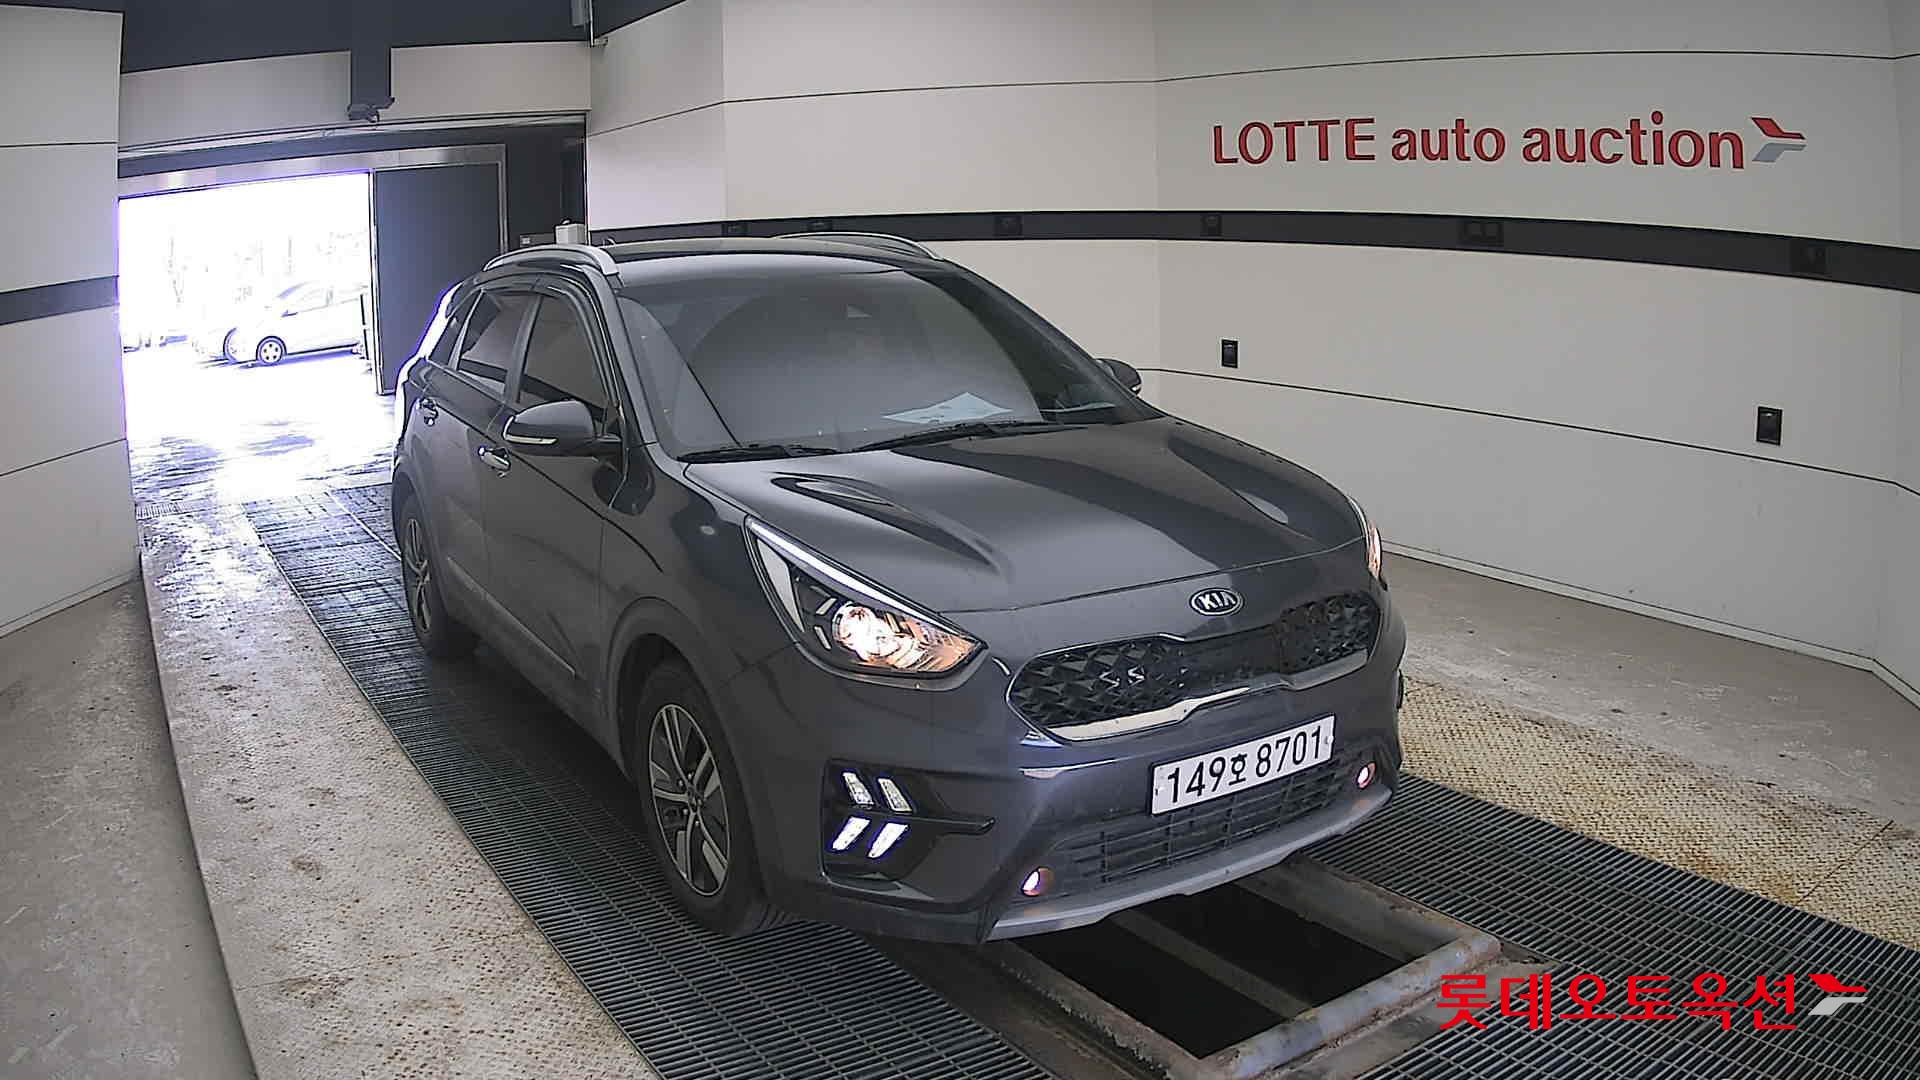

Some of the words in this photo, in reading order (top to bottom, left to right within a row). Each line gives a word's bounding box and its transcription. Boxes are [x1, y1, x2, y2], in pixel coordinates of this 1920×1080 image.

[1212, 117, 1377, 165] LOTTE
[1391, 118, 1507, 164] auto
[1522, 110, 1746, 170] auction
[1198, 591, 1237, 612] KIA
